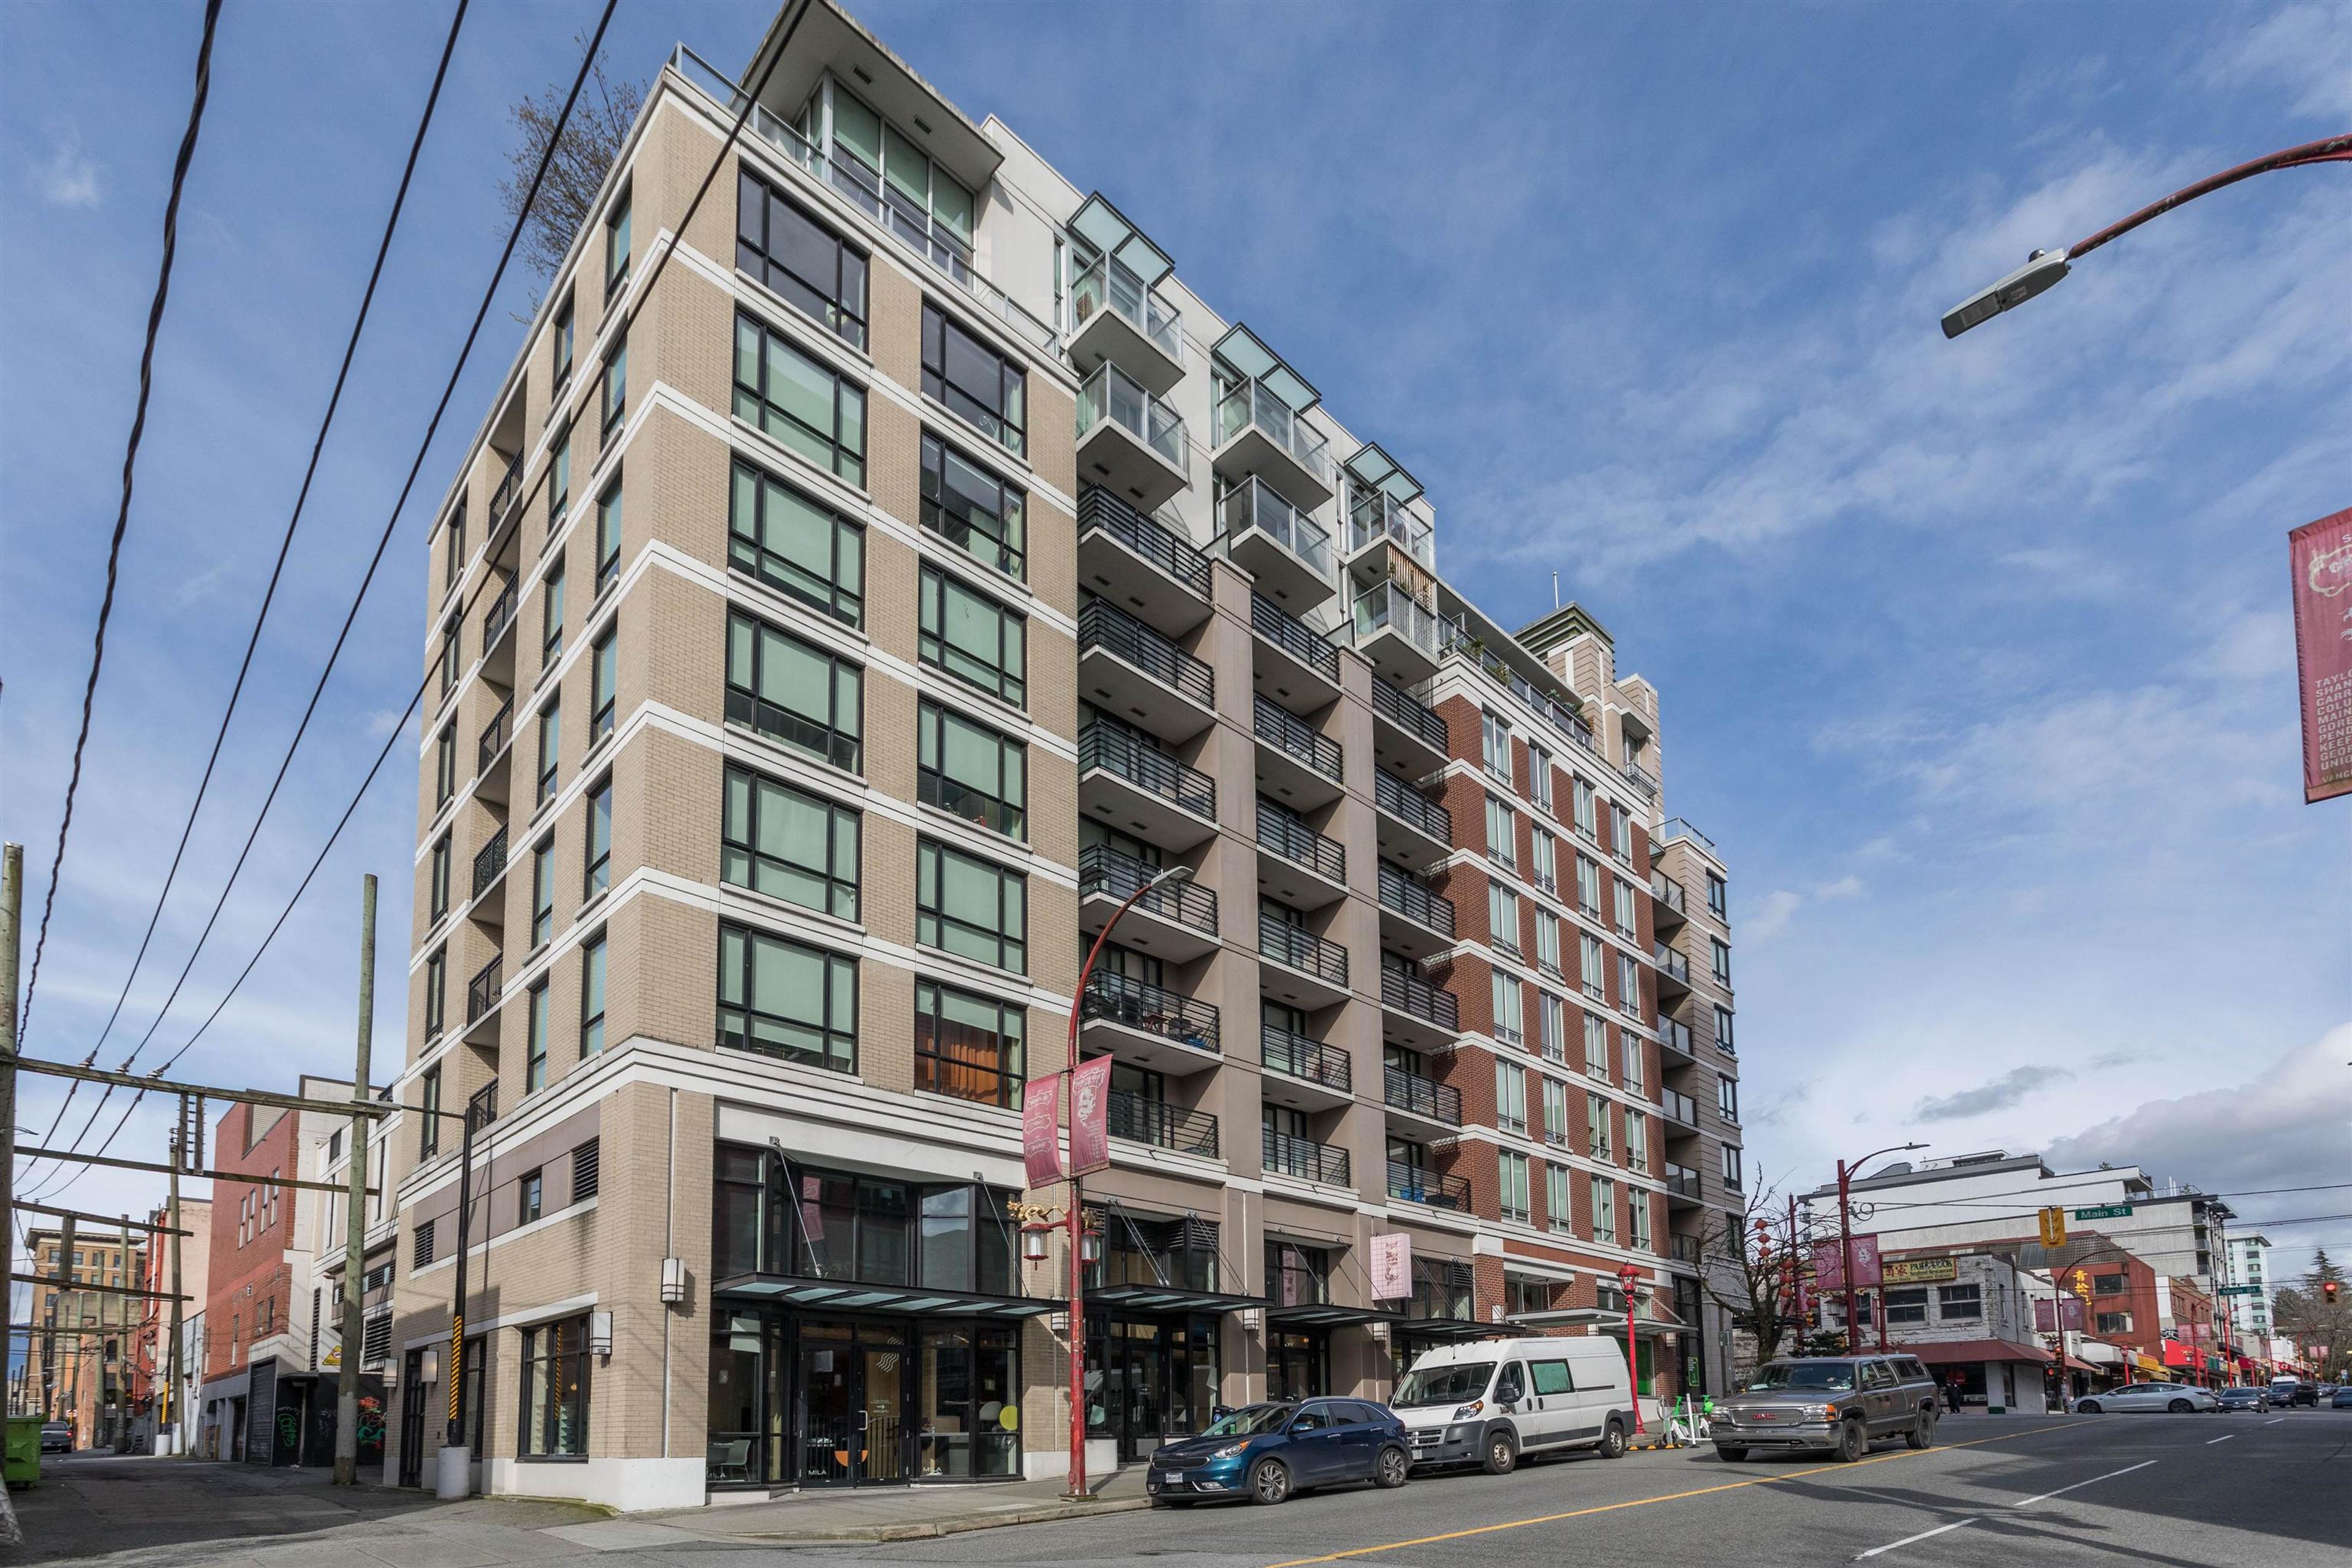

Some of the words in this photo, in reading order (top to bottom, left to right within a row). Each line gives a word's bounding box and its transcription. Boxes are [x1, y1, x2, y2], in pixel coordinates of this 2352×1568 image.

[2316, 679, 2352, 697] SHAN
[2316, 689, 2352, 706] CARR
[2317, 698, 2352, 716] COLU
[2318, 707, 2352, 725] MAIN
[2318, 716, 2352, 734] GORE
[2320, 736, 2352, 752] KEEF
[2321, 755, 2352, 771] UNIO
[2322, 770, 2352, 783] VANC
[2081, 1210, 2108, 1219] Main
